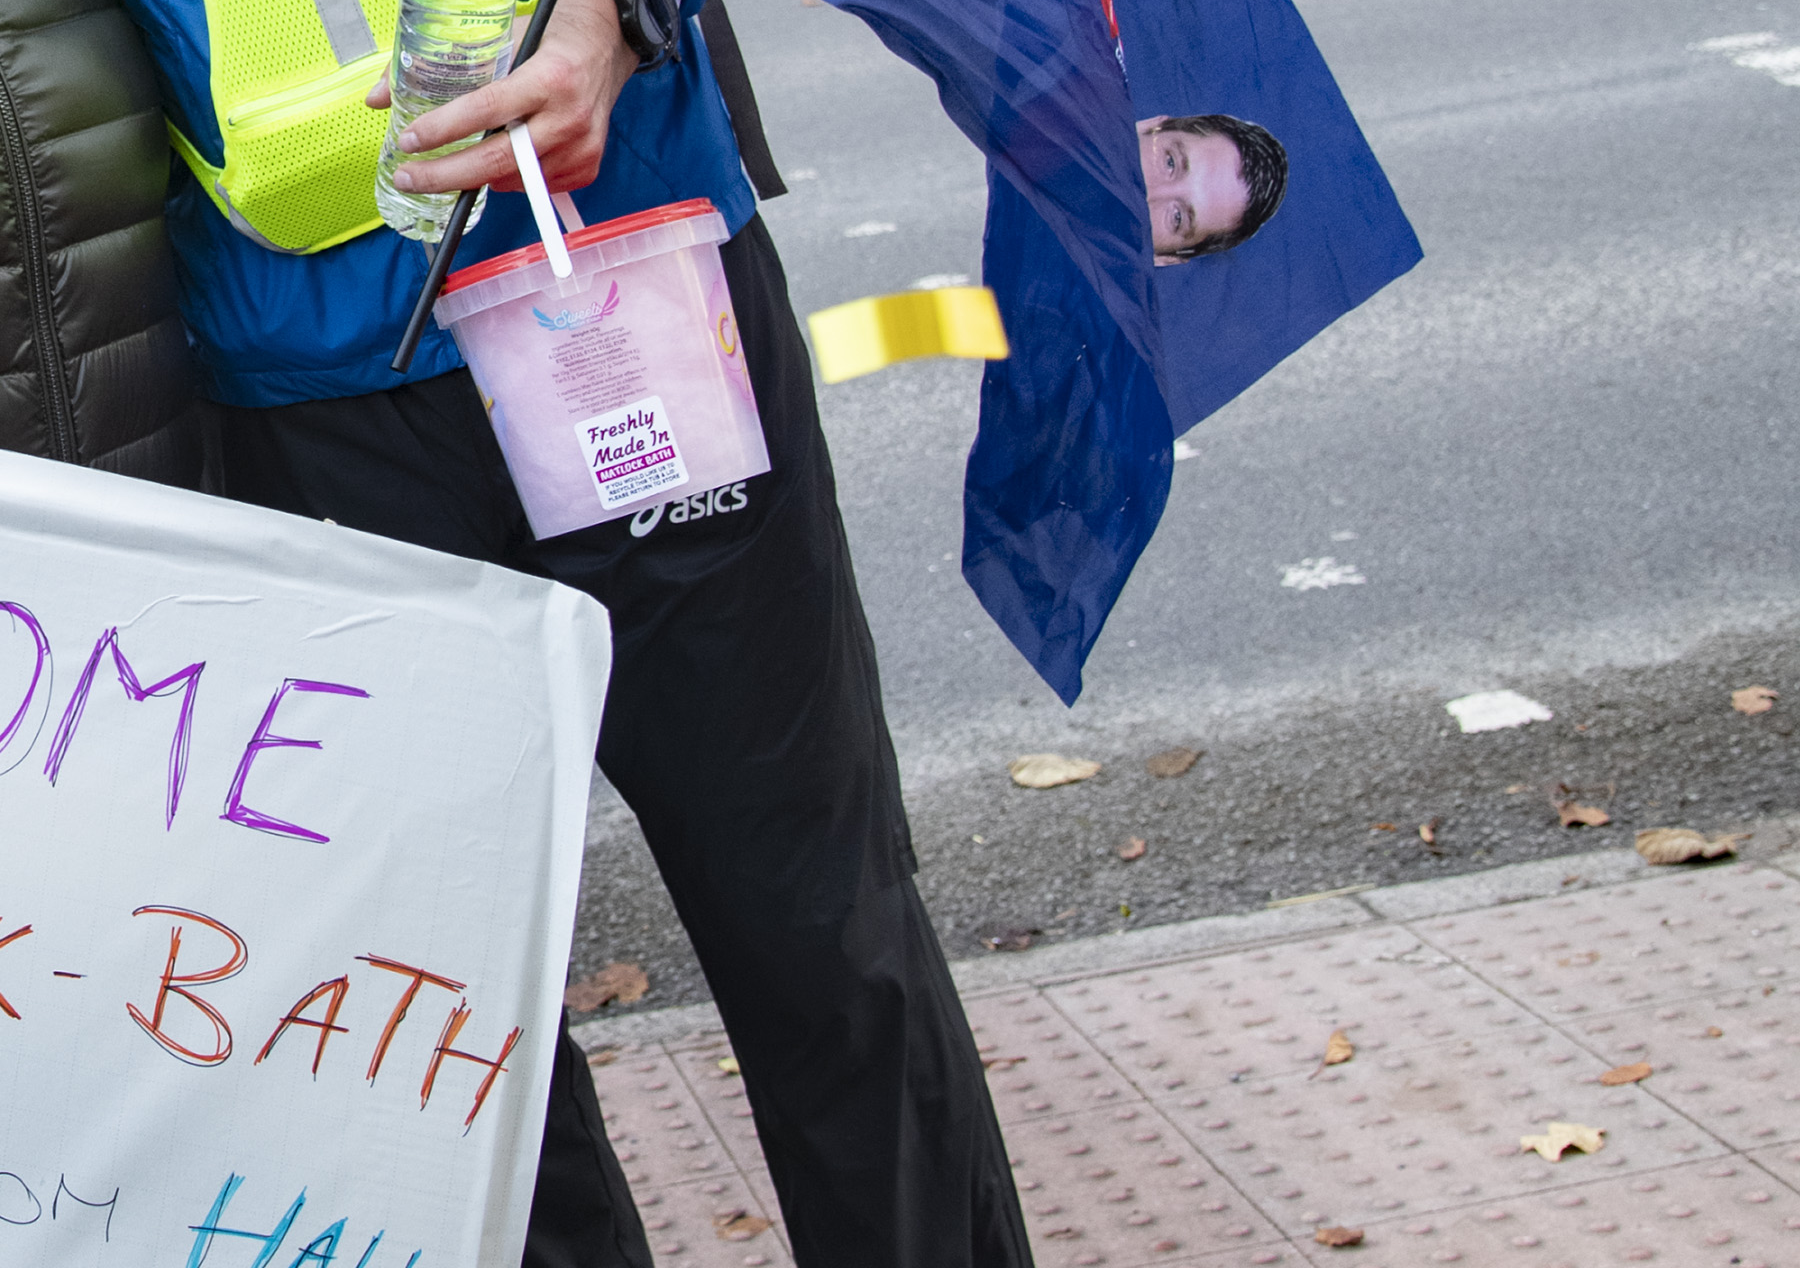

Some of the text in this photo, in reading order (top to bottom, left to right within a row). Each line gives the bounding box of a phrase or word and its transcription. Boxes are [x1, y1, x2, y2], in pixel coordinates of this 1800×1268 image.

[587, 410, 654, 444] Freshly
[593, 430, 670, 467] Made In
[600, 448, 672, 482] MATLOCK BATH
[608, 491, 629, 502] PLEASE
[630, 484, 652, 495] RETURN
[609, 483, 634, 495] RECYCLE
[624, 473, 644, 484] WOULD
[669, 482, 748, 523] asics
